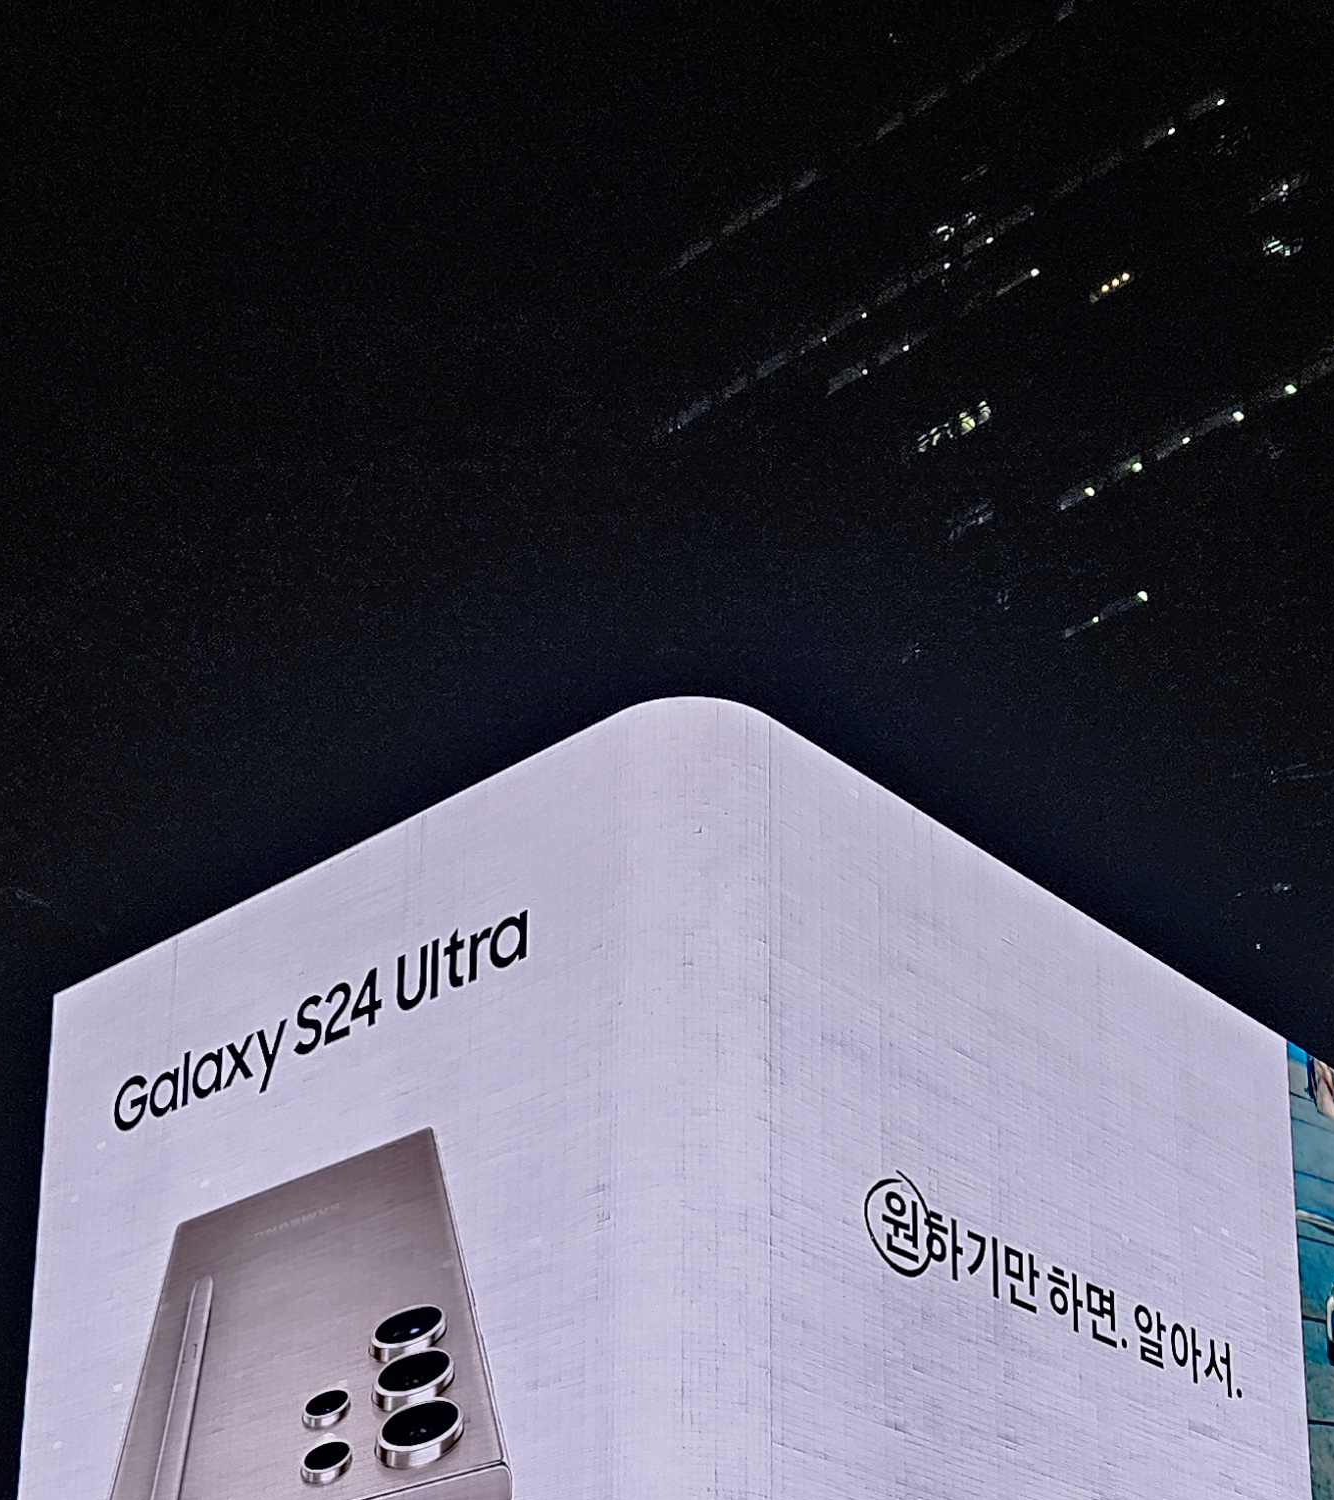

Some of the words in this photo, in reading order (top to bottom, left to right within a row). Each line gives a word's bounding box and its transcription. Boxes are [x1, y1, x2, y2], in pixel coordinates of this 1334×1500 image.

[113, 1016, 288, 1132] Galaxy
[293, 967, 382, 1056] S24
[396, 908, 529, 1011] Ultra
[880, 1189, 1040, 1314] 원하기만
[1047, 1265, 1129, 1350] 하면.
[1133, 1303, 1244, 1400] 알아서.
